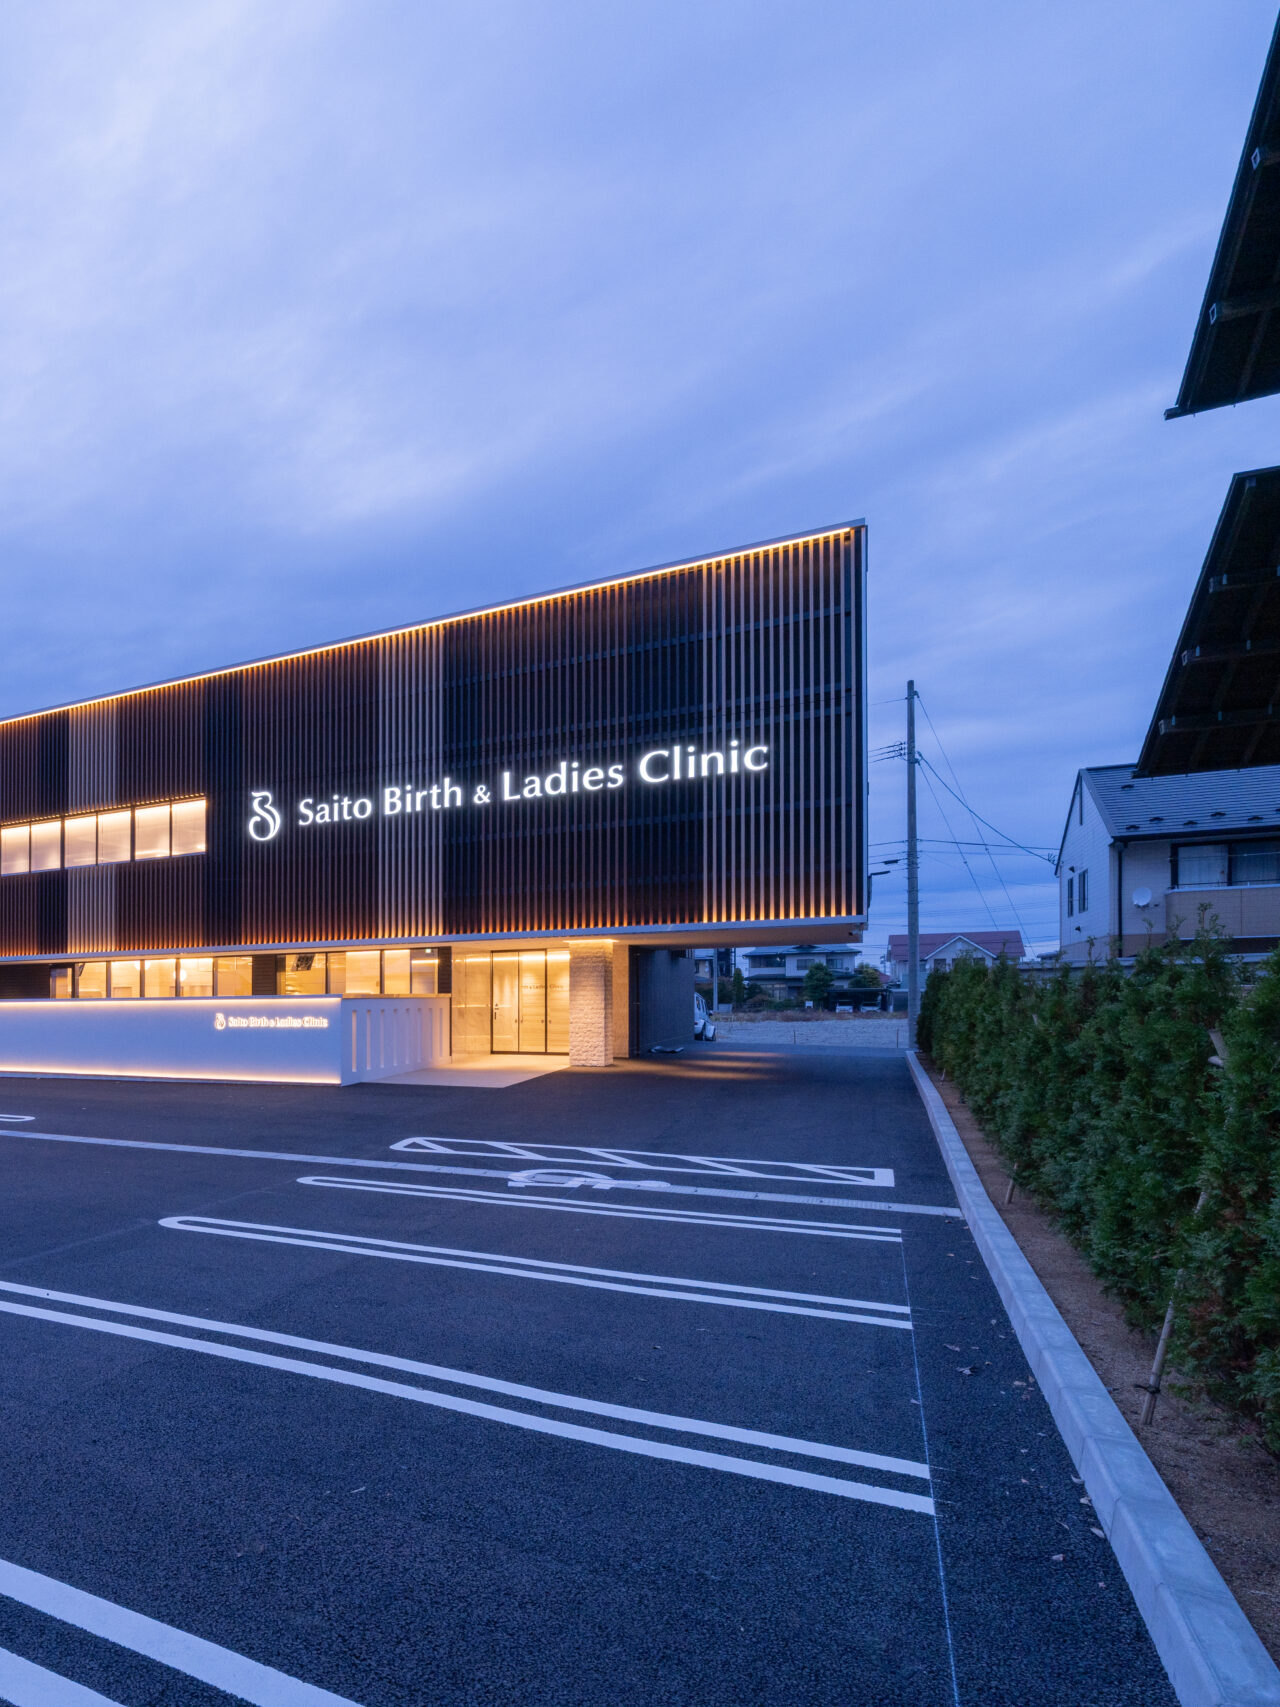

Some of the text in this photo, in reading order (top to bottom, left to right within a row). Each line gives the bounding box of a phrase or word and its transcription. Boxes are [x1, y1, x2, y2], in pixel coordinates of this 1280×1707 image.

[298, 739, 768, 826] Saito Birth & Ladies Clinic
